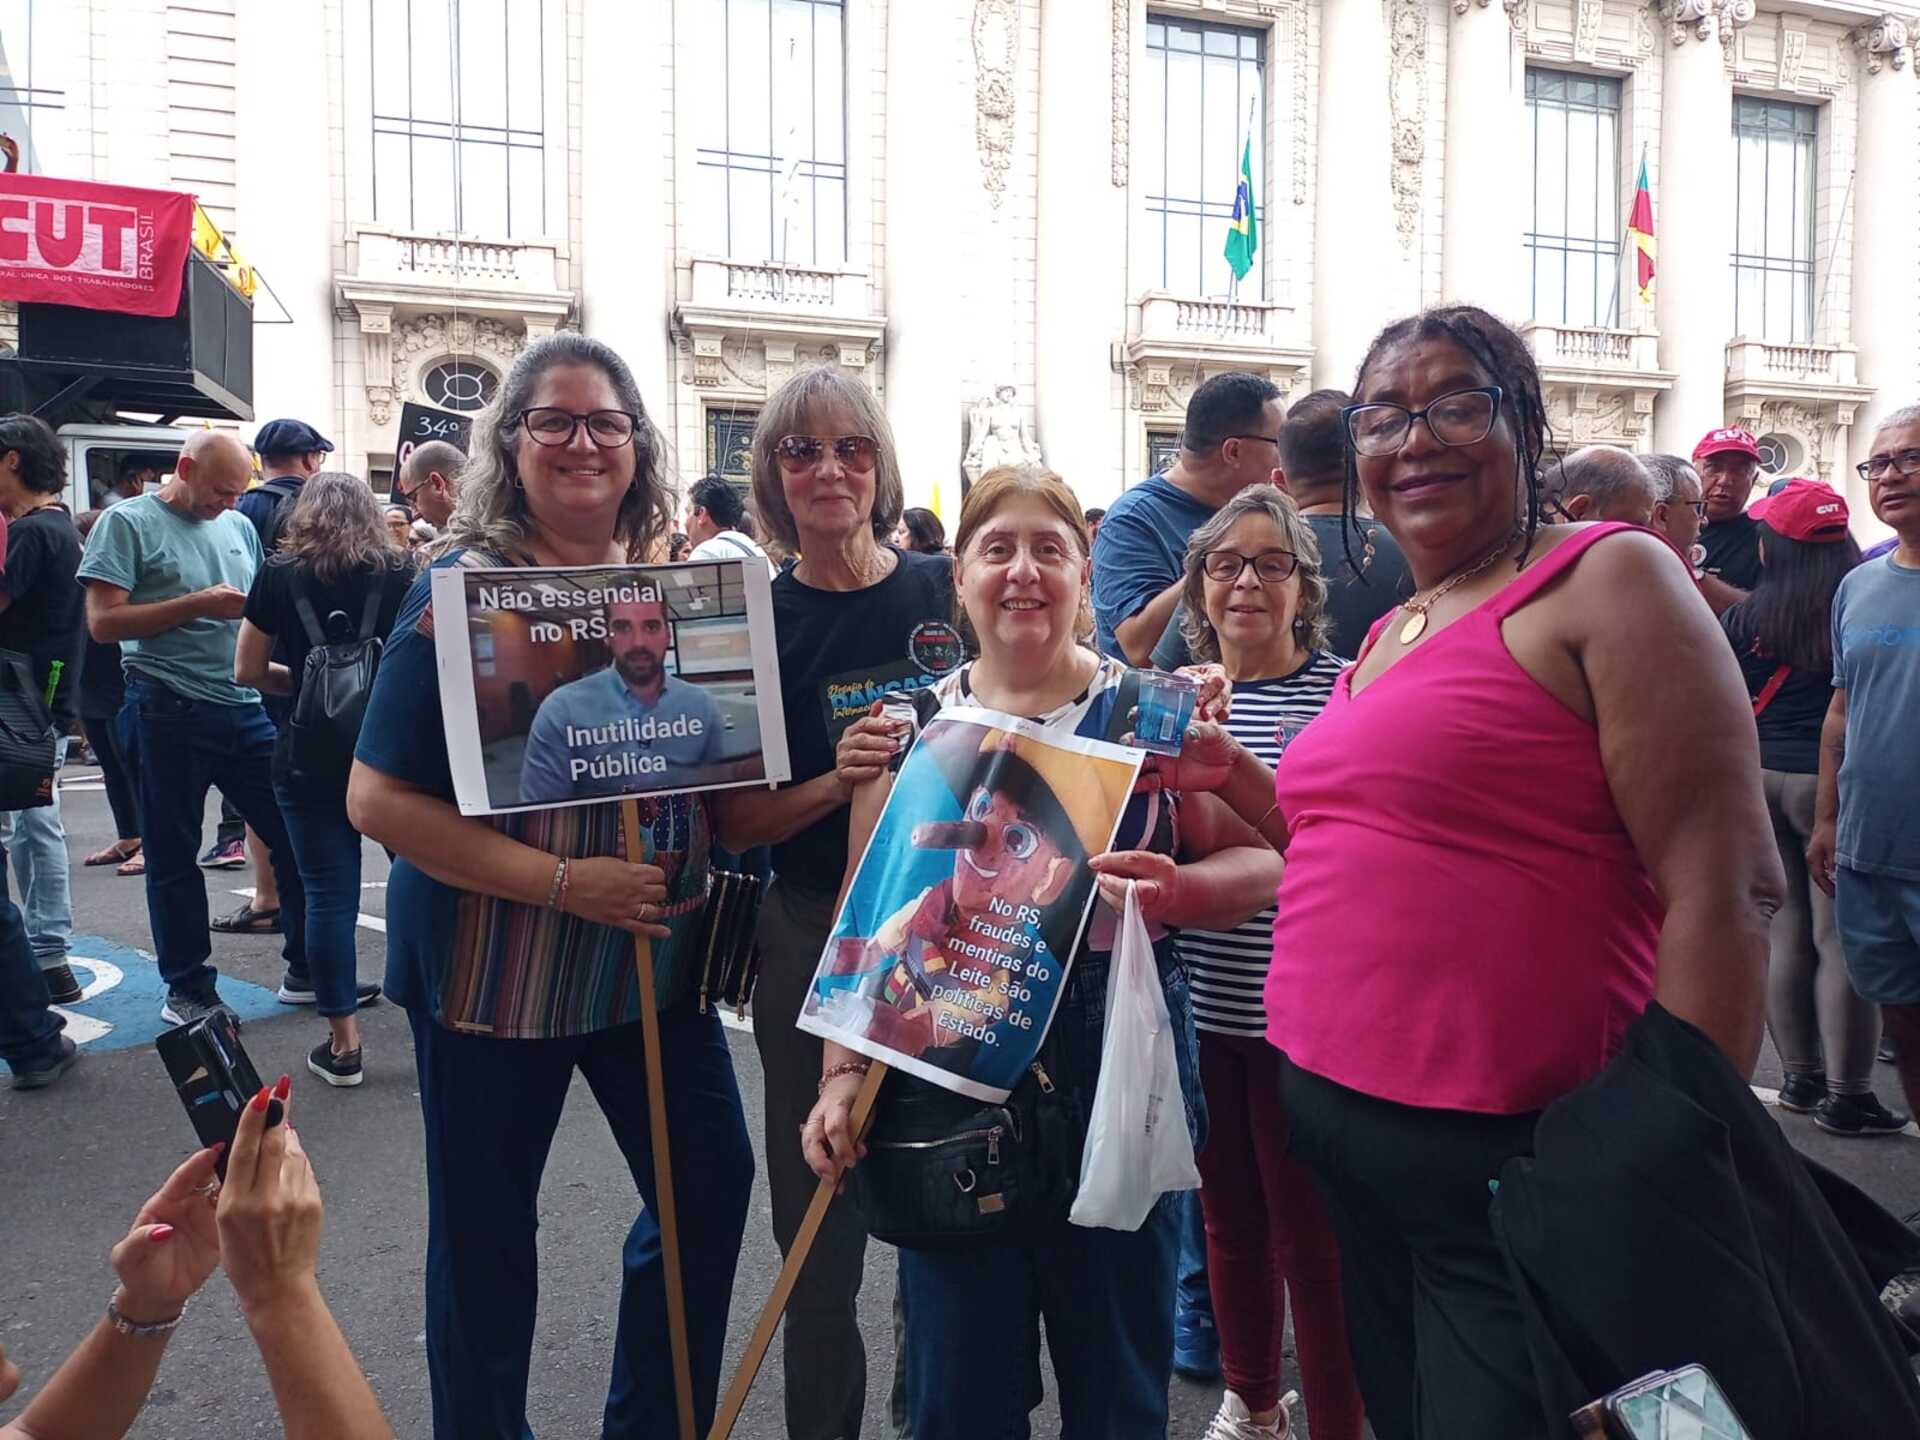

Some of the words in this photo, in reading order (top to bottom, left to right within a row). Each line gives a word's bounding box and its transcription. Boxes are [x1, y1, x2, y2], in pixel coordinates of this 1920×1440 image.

[0, 200, 135, 271] CUT
[138, 208, 154, 281] BRASIL
[53, 274, 72, 283] DOS
[1816, 503, 1840, 514] CUT
[479, 585, 533, 611] Não
[541, 580, 664, 608] essencial
[530, 622, 563, 643] no
[571, 616, 615, 641] RS.
[567, 713, 703, 748] Inutilidade
[569, 752, 668, 782] Pública
[988, 896, 1013, 917] No
[1015, 904, 1041, 930] RS,
[968, 917, 1030, 950] fraudes
[1034, 939, 1047, 954] e
[948, 936, 1022, 973] mentiras
[1026, 962, 1050, 983] do
[949, 960, 993, 994] Leite,
[998, 980, 1032, 1003] são
[930, 983, 1004, 1021] políticas
[1008, 1007, 1033, 1031] de
[937, 1010, 1001, 1048] Estado.
